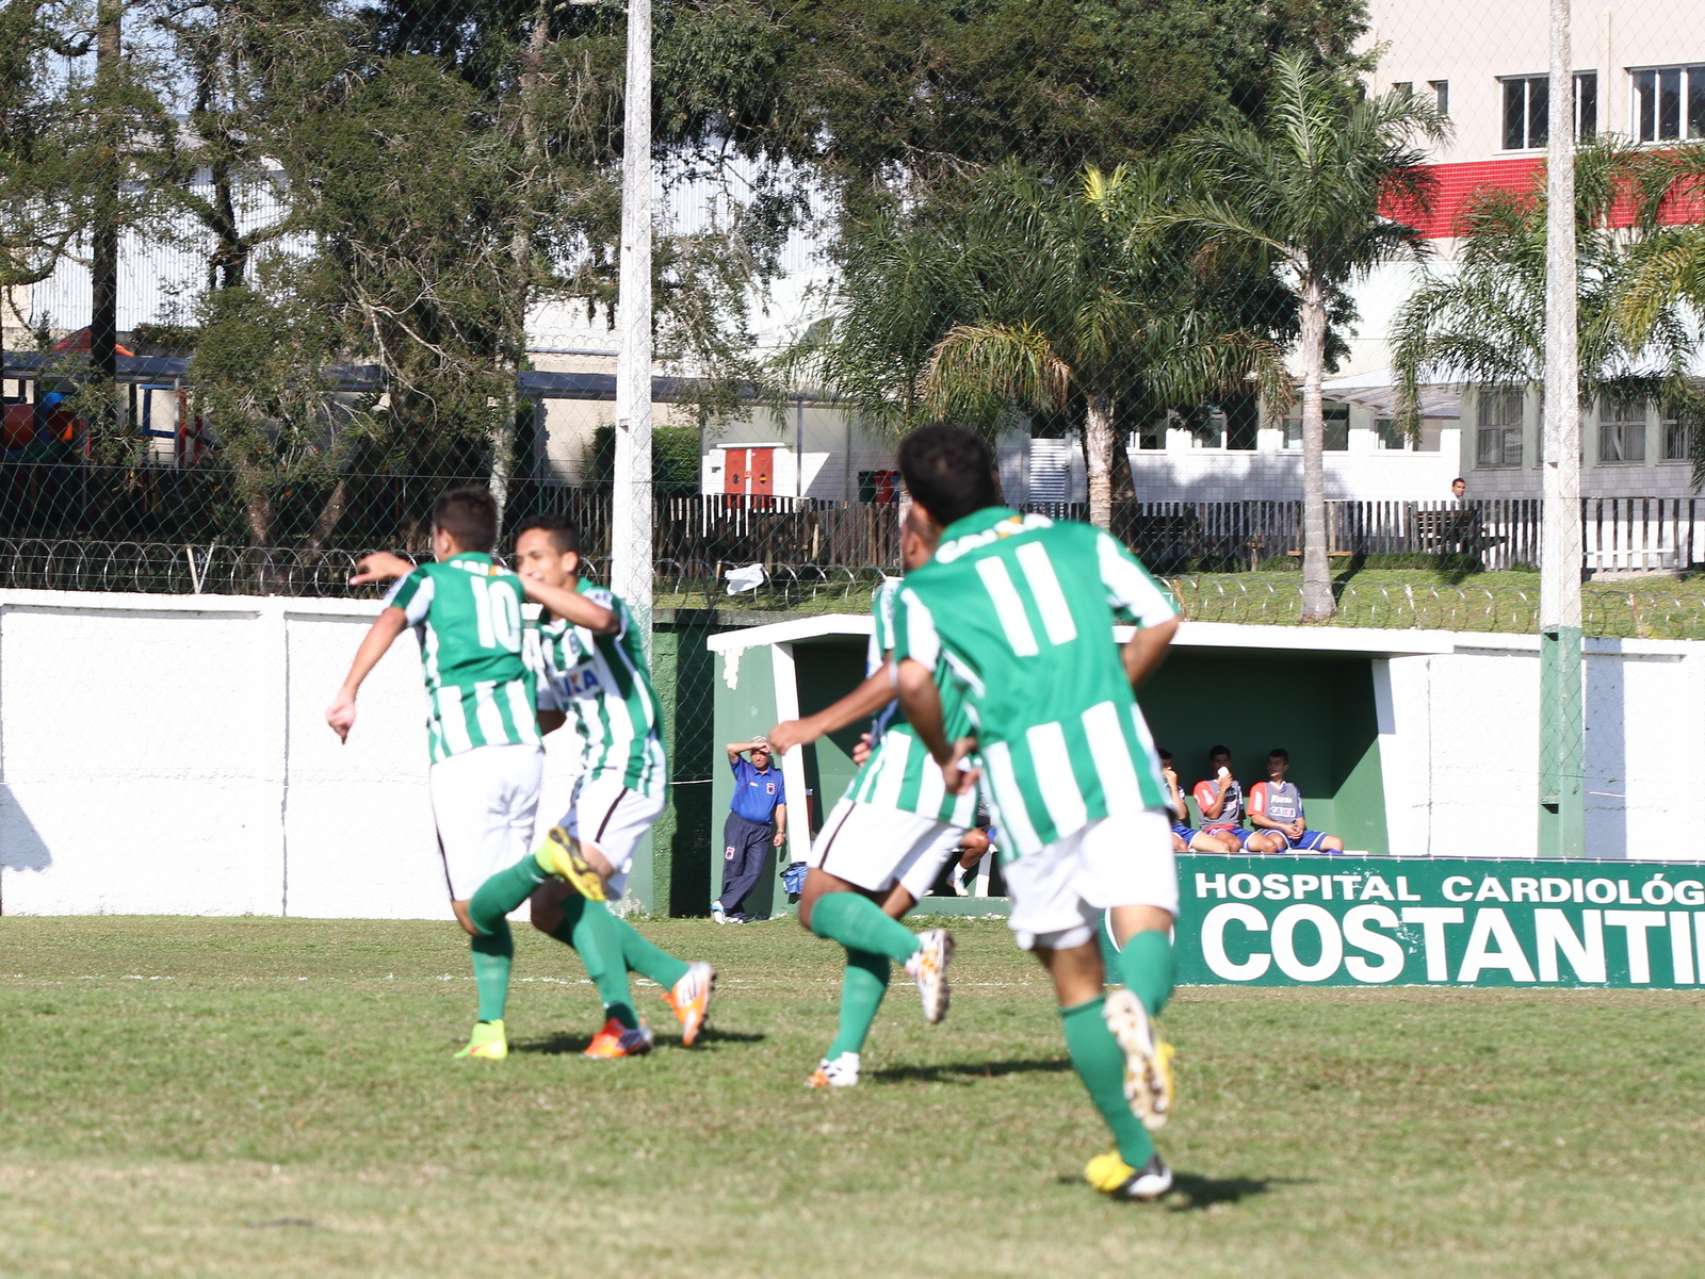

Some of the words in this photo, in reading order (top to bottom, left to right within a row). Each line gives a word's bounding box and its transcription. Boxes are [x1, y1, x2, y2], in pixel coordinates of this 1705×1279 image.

[471, 576, 522, 652] 10
[975, 541, 1077, 656] 11
[1195, 873, 1421, 901] HOSPITAL
[1201, 902, 1705, 984] COSTANTI
